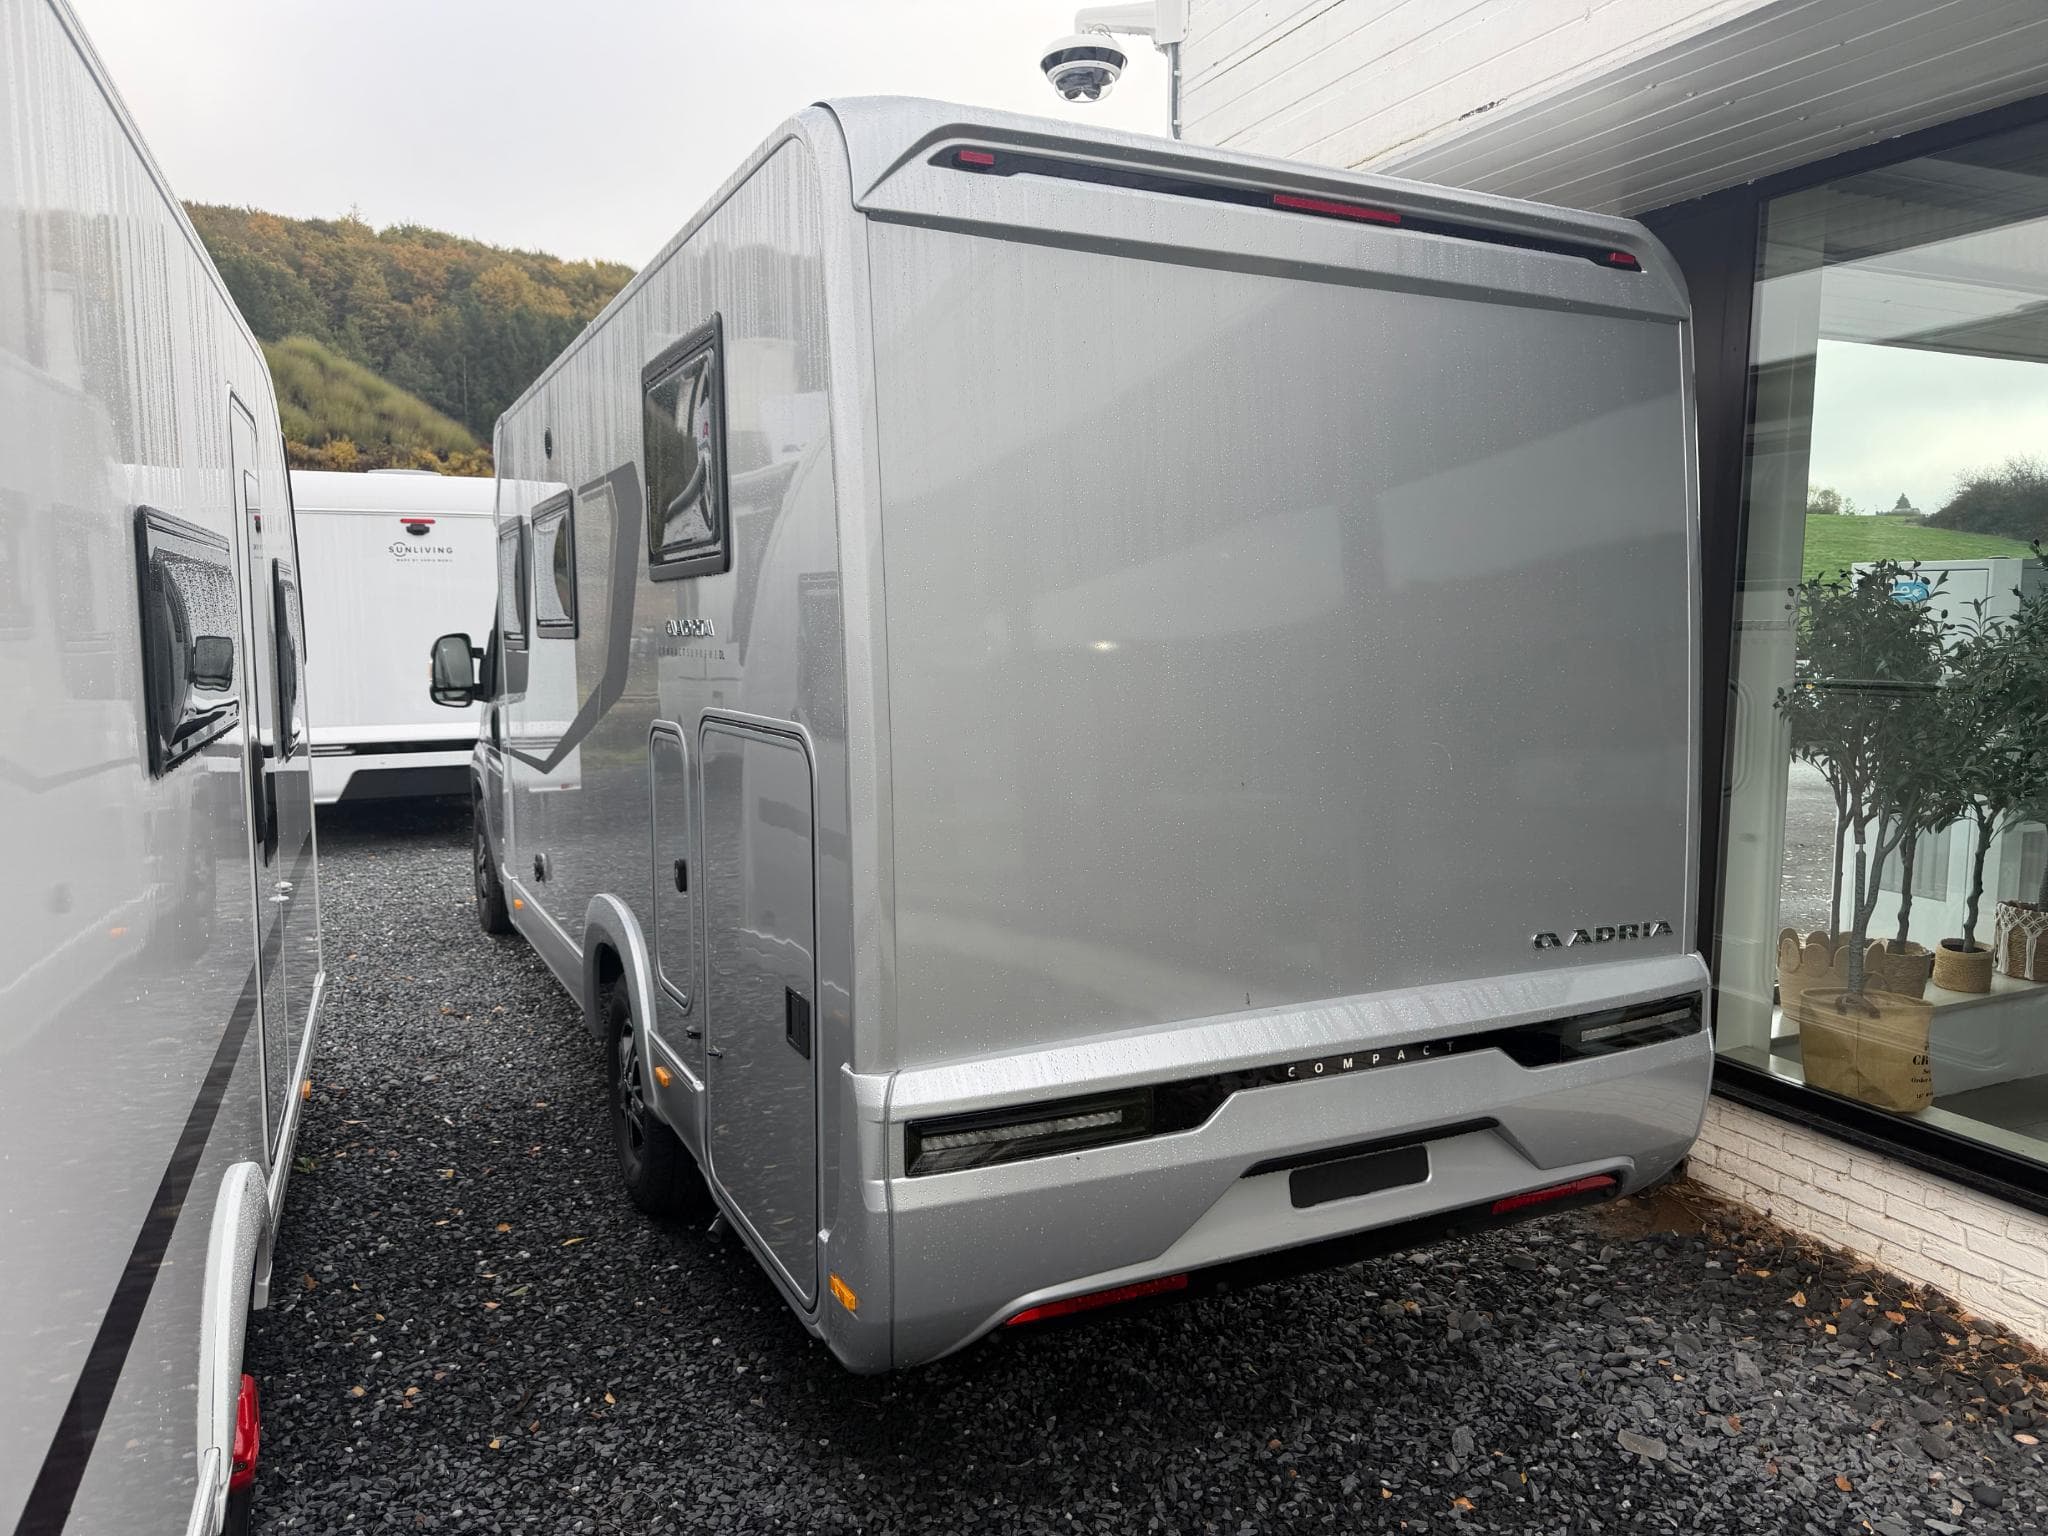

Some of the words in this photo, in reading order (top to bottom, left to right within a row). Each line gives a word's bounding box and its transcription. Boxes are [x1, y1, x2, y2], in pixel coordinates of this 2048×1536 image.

[388, 544, 453, 555] SUNLIVING
[1567, 920, 1674, 947] ADRIA
[1287, 1041, 1455, 1077] COMPACT
